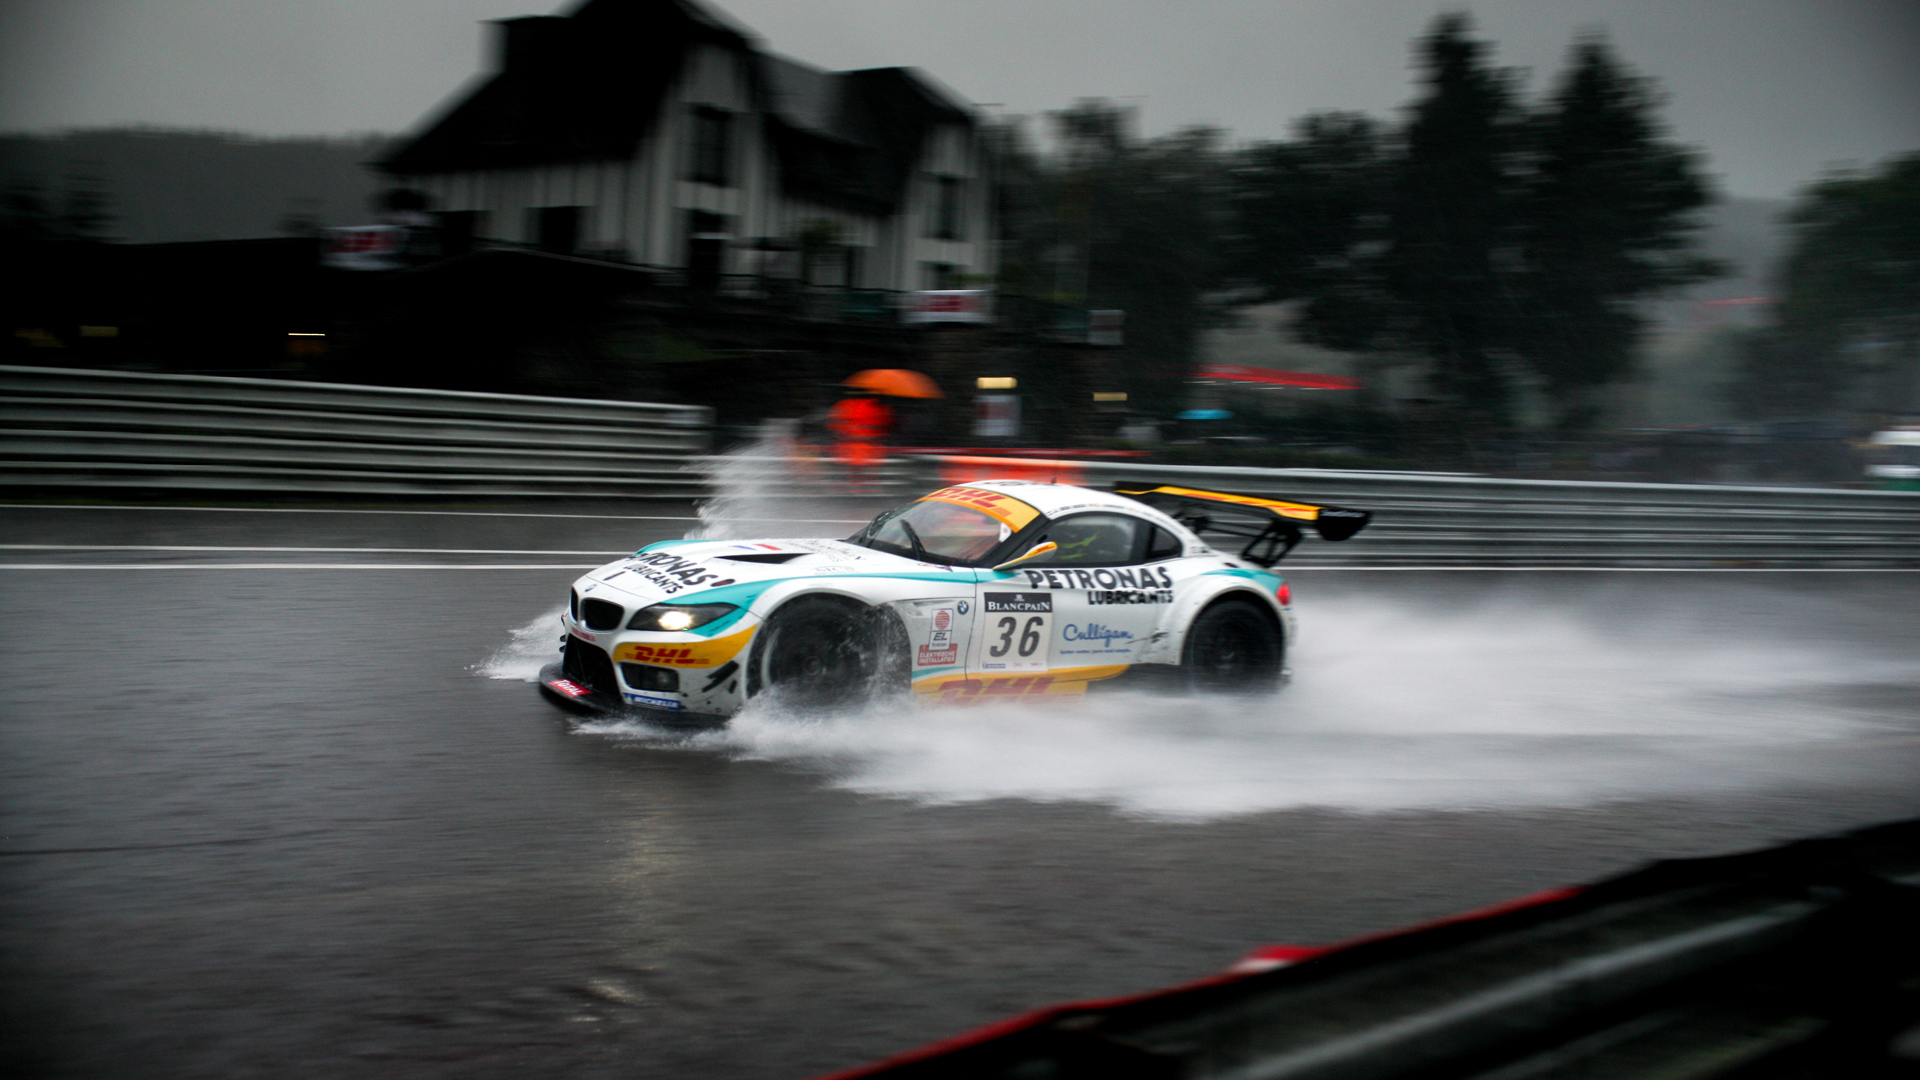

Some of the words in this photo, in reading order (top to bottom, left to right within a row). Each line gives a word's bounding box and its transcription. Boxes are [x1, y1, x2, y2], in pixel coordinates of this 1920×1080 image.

[929, 488, 1006, 508] DHL
[626, 552, 719, 586] TRONAS
[623, 564, 684, 594] LBRICANTS
[1023, 567, 1173, 590] PETRONAS
[988, 601, 1050, 611] BLANCPAIN
[1088, 590, 1174, 605] LUBRICANTS
[933, 632, 948, 641] EL
[990, 616, 1044, 657] 36
[633, 646, 697, 664] DHL
[918, 656, 955, 664] INSTALLATIES
[919, 650, 956, 658] ELEKTRISCHE
[554, 679, 584, 696] TOTAL
[938, 677, 1061, 706] DHL
